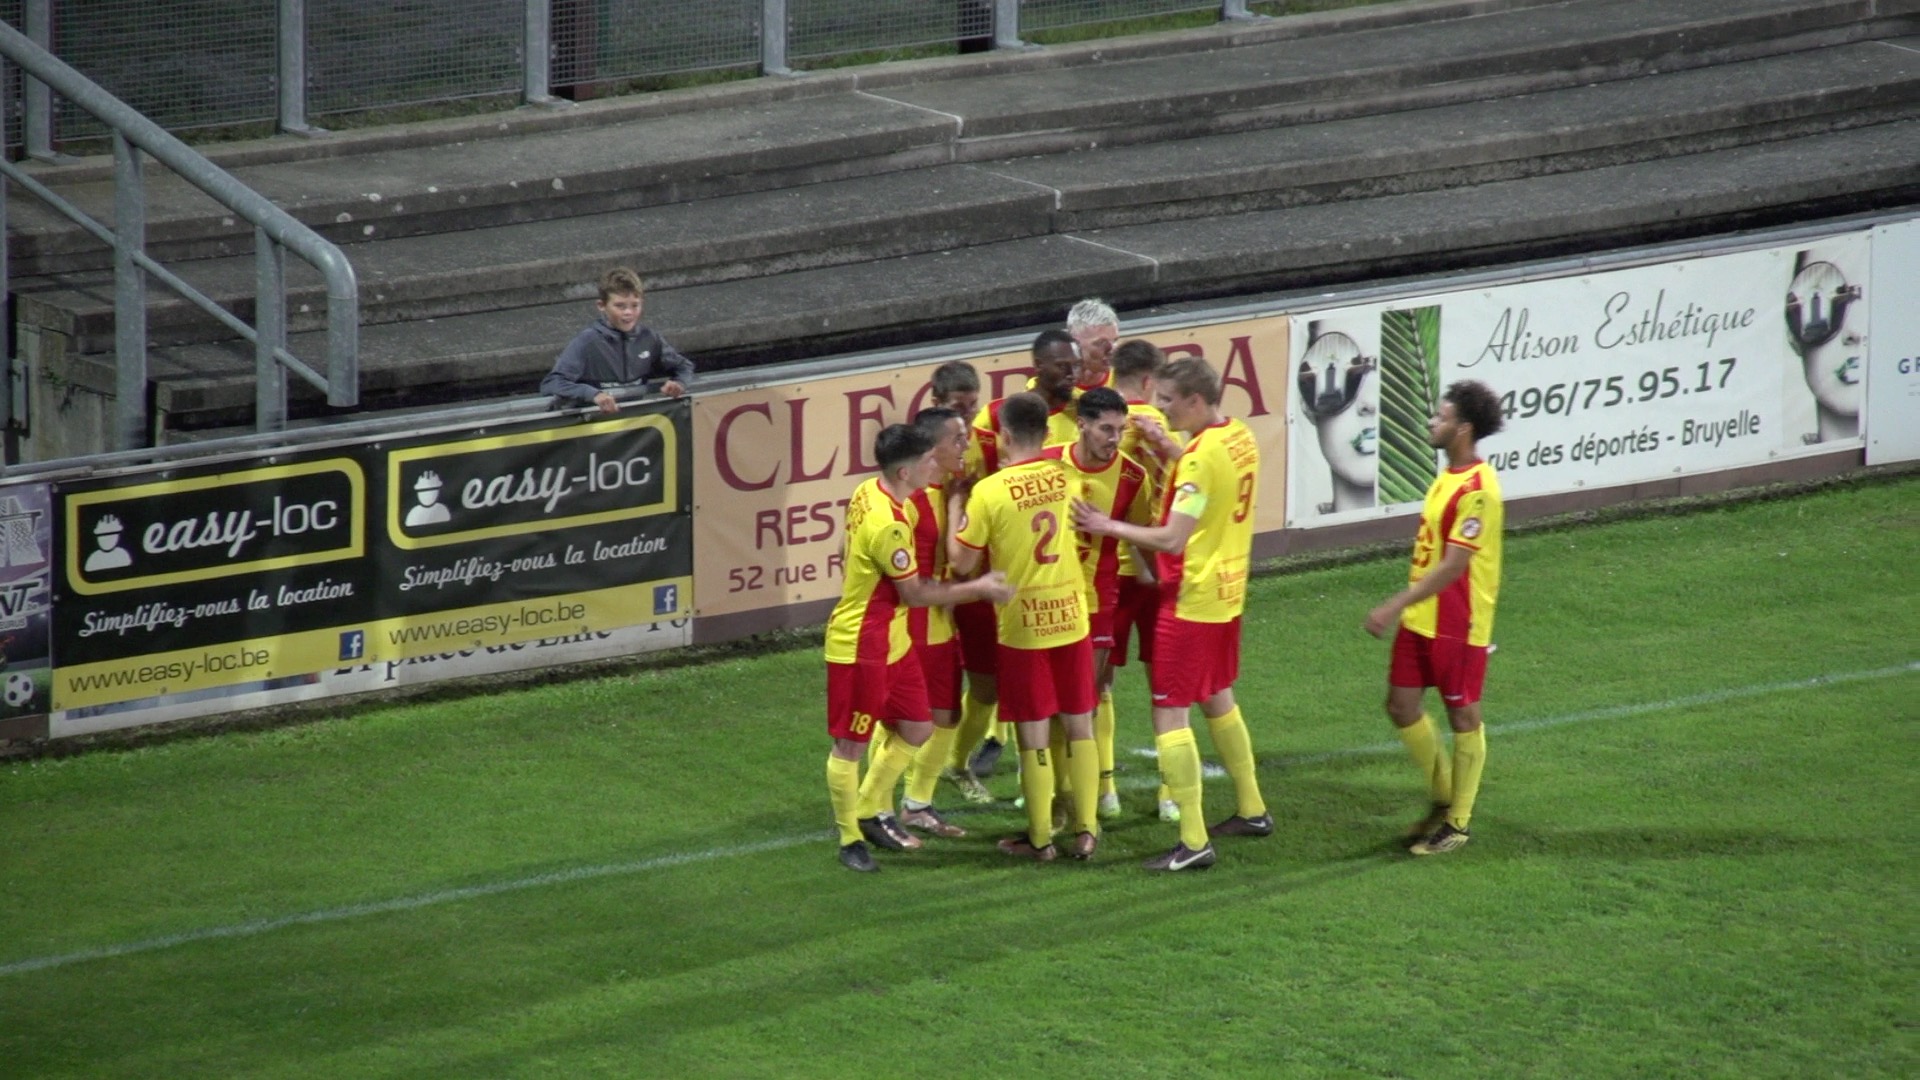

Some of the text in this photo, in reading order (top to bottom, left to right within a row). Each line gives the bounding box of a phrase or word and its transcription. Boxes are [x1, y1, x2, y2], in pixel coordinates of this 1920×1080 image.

[1457, 289, 1755, 368] Alison Esthétique
[1527, 441, 1563, 468] des
[1570, 425, 1659, 466] déportés
[1682, 409, 1760, 447] Bruyelle
[461, 452, 650, 514] easy-loc
[1009, 473, 1067, 501] DELYS
[1017, 491, 1065, 512] FRASNES
[1233, 471, 1255, 524] 9
[142, 496, 337, 557] easy-loc
[1031, 511, 1060, 564] 2
[399, 533, 667, 590] Simplifiez-vous la location
[729, 566, 763, 593] 52
[775, 564, 817, 586] rue
[78, 578, 354, 637] Simplifiez-vous la location
[389, 602, 586, 645] www.easy-loc.be
[69, 647, 269, 693] www.easy-loc.be
[850, 711, 871, 735] 18
